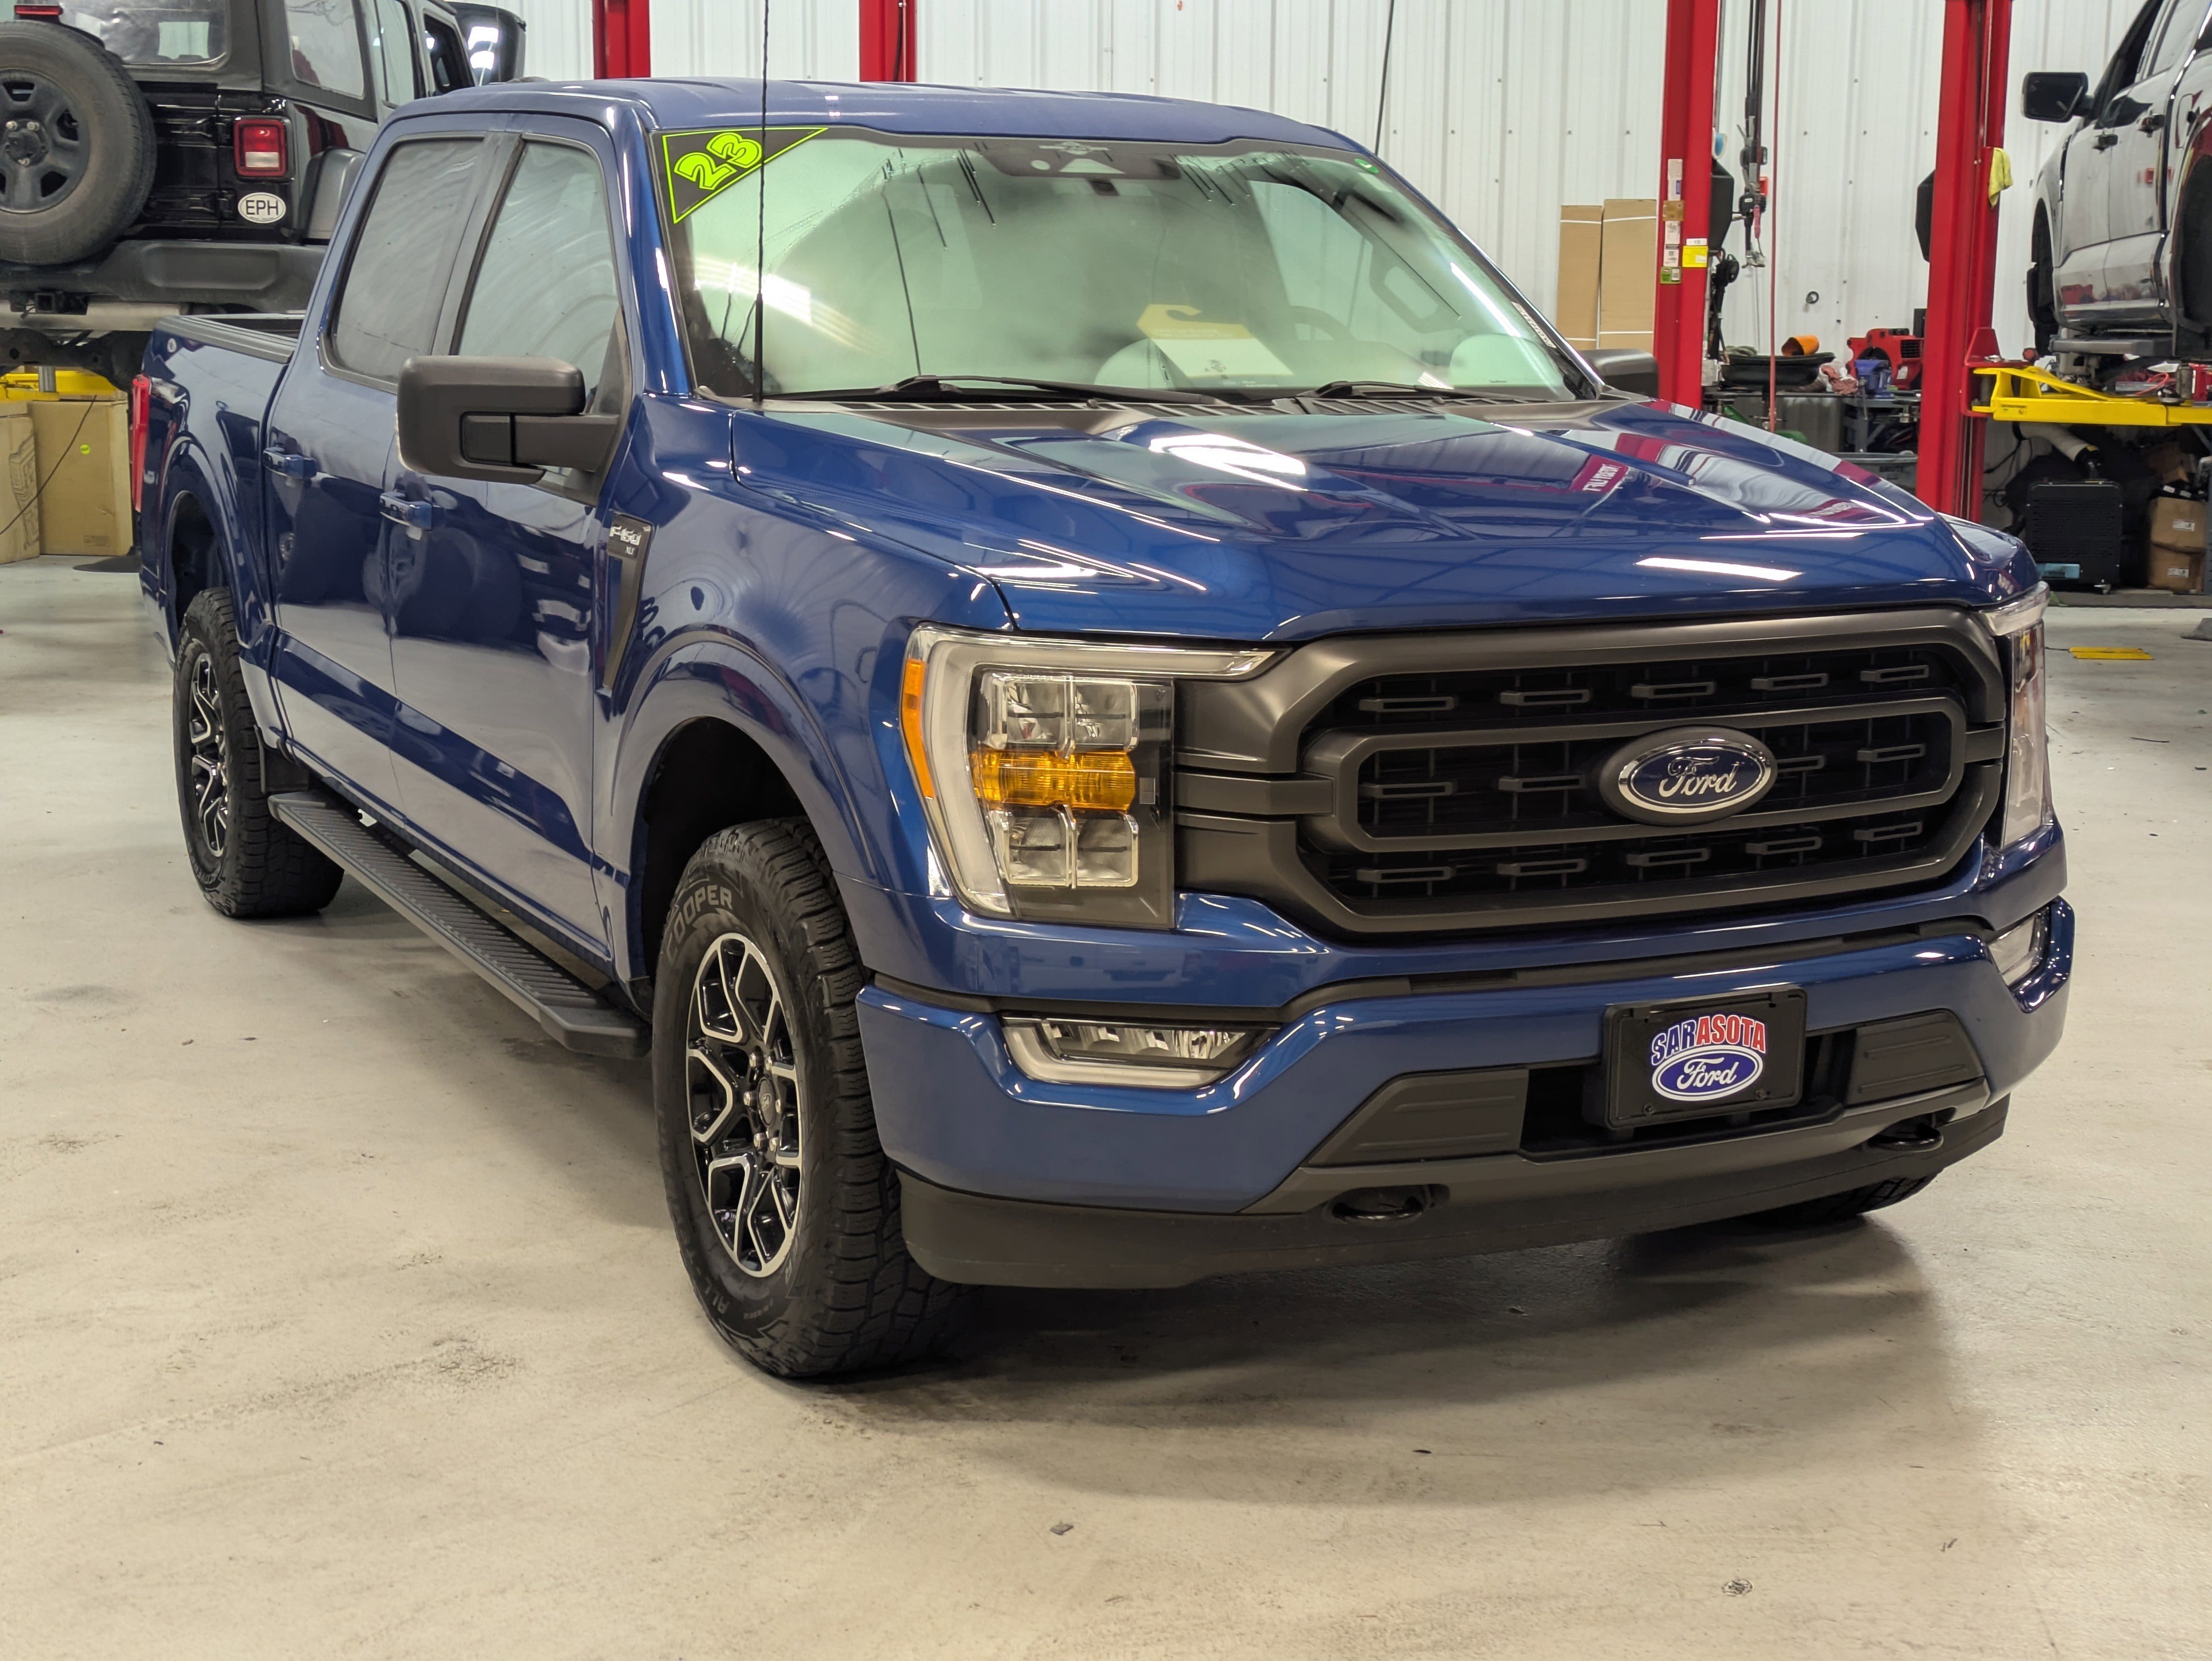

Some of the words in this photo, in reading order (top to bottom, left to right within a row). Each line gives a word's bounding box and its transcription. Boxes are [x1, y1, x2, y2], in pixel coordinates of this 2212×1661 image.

[674, 133, 762, 190] 23
[246, 200, 278, 215] EPH
[1659, 755, 1739, 797] Ford
[666, 885, 733, 962] COOPER
[1651, 1014, 1766, 1066] SARASOTA
[1677, 1057, 1739, 1089] Ford
